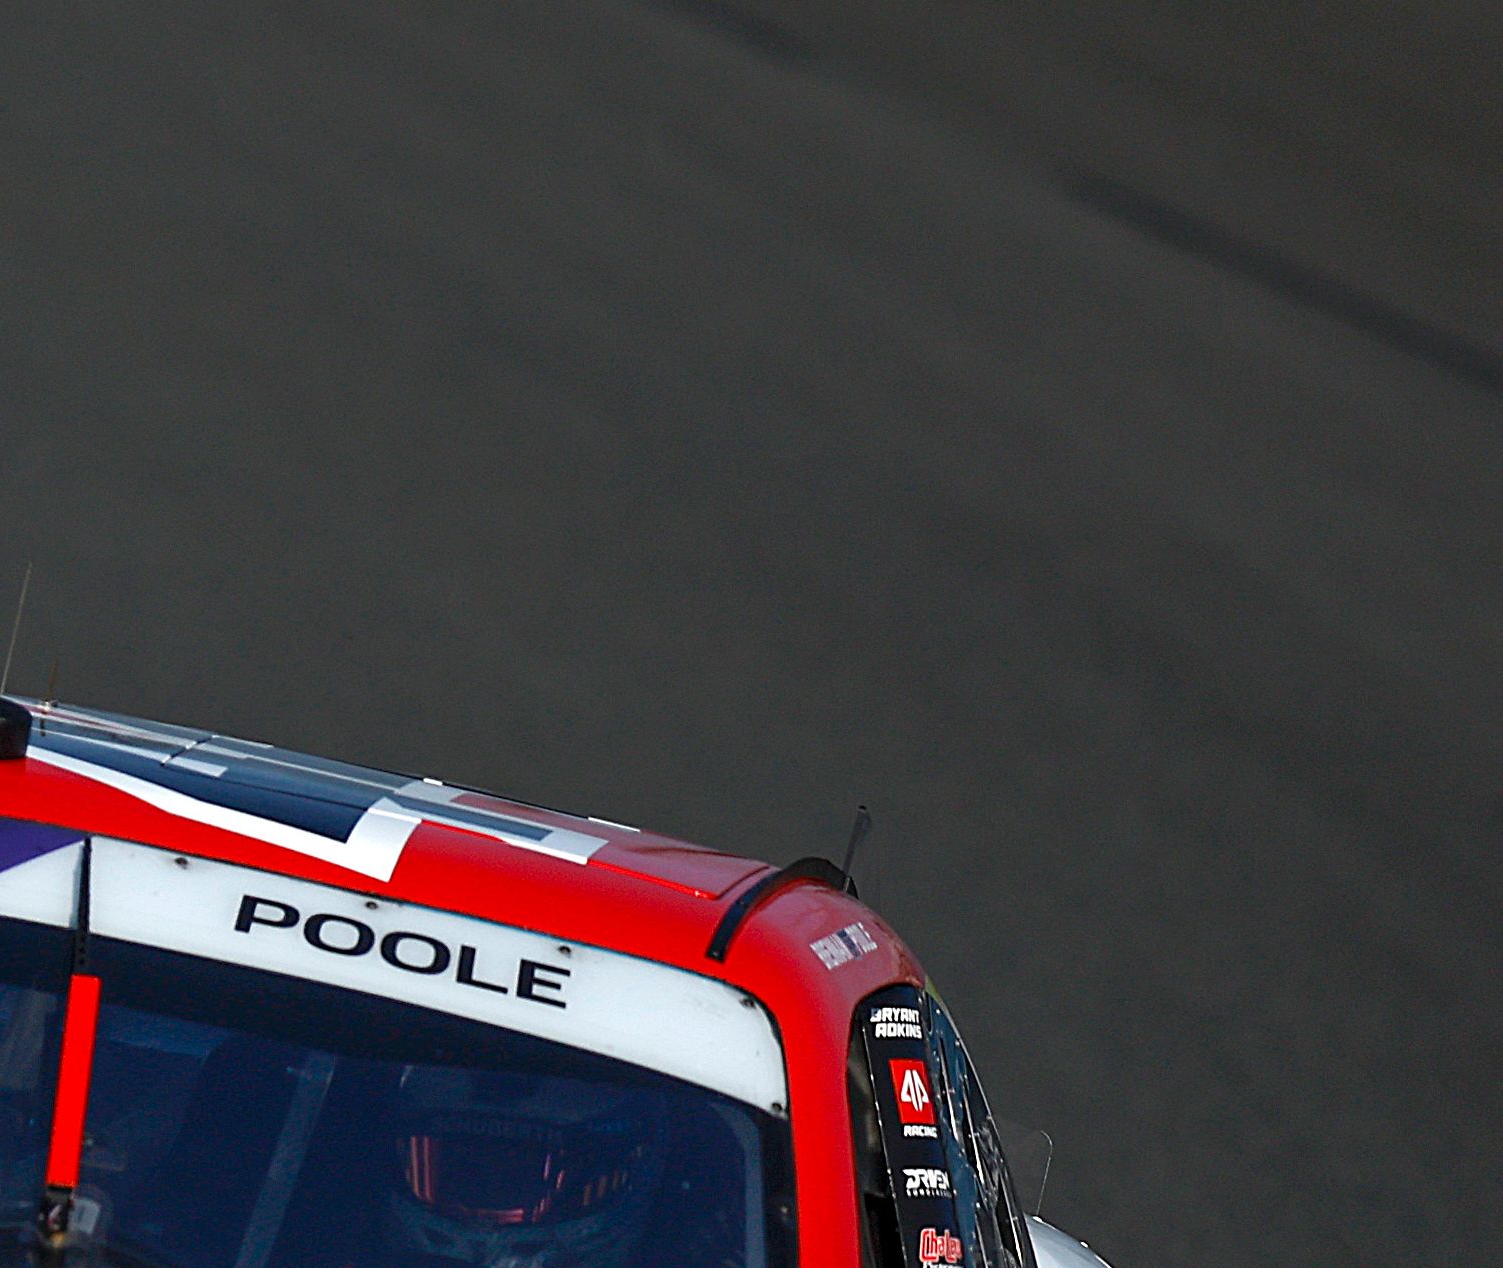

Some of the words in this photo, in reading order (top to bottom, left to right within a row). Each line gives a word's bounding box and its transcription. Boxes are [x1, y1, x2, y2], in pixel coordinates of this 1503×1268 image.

[234, 894, 572, 1009] POOLE
[870, 1007, 920, 1023] BRYANT
[875, 1022, 923, 1039] ADKINS
[903, 1125, 938, 1138] RACING
